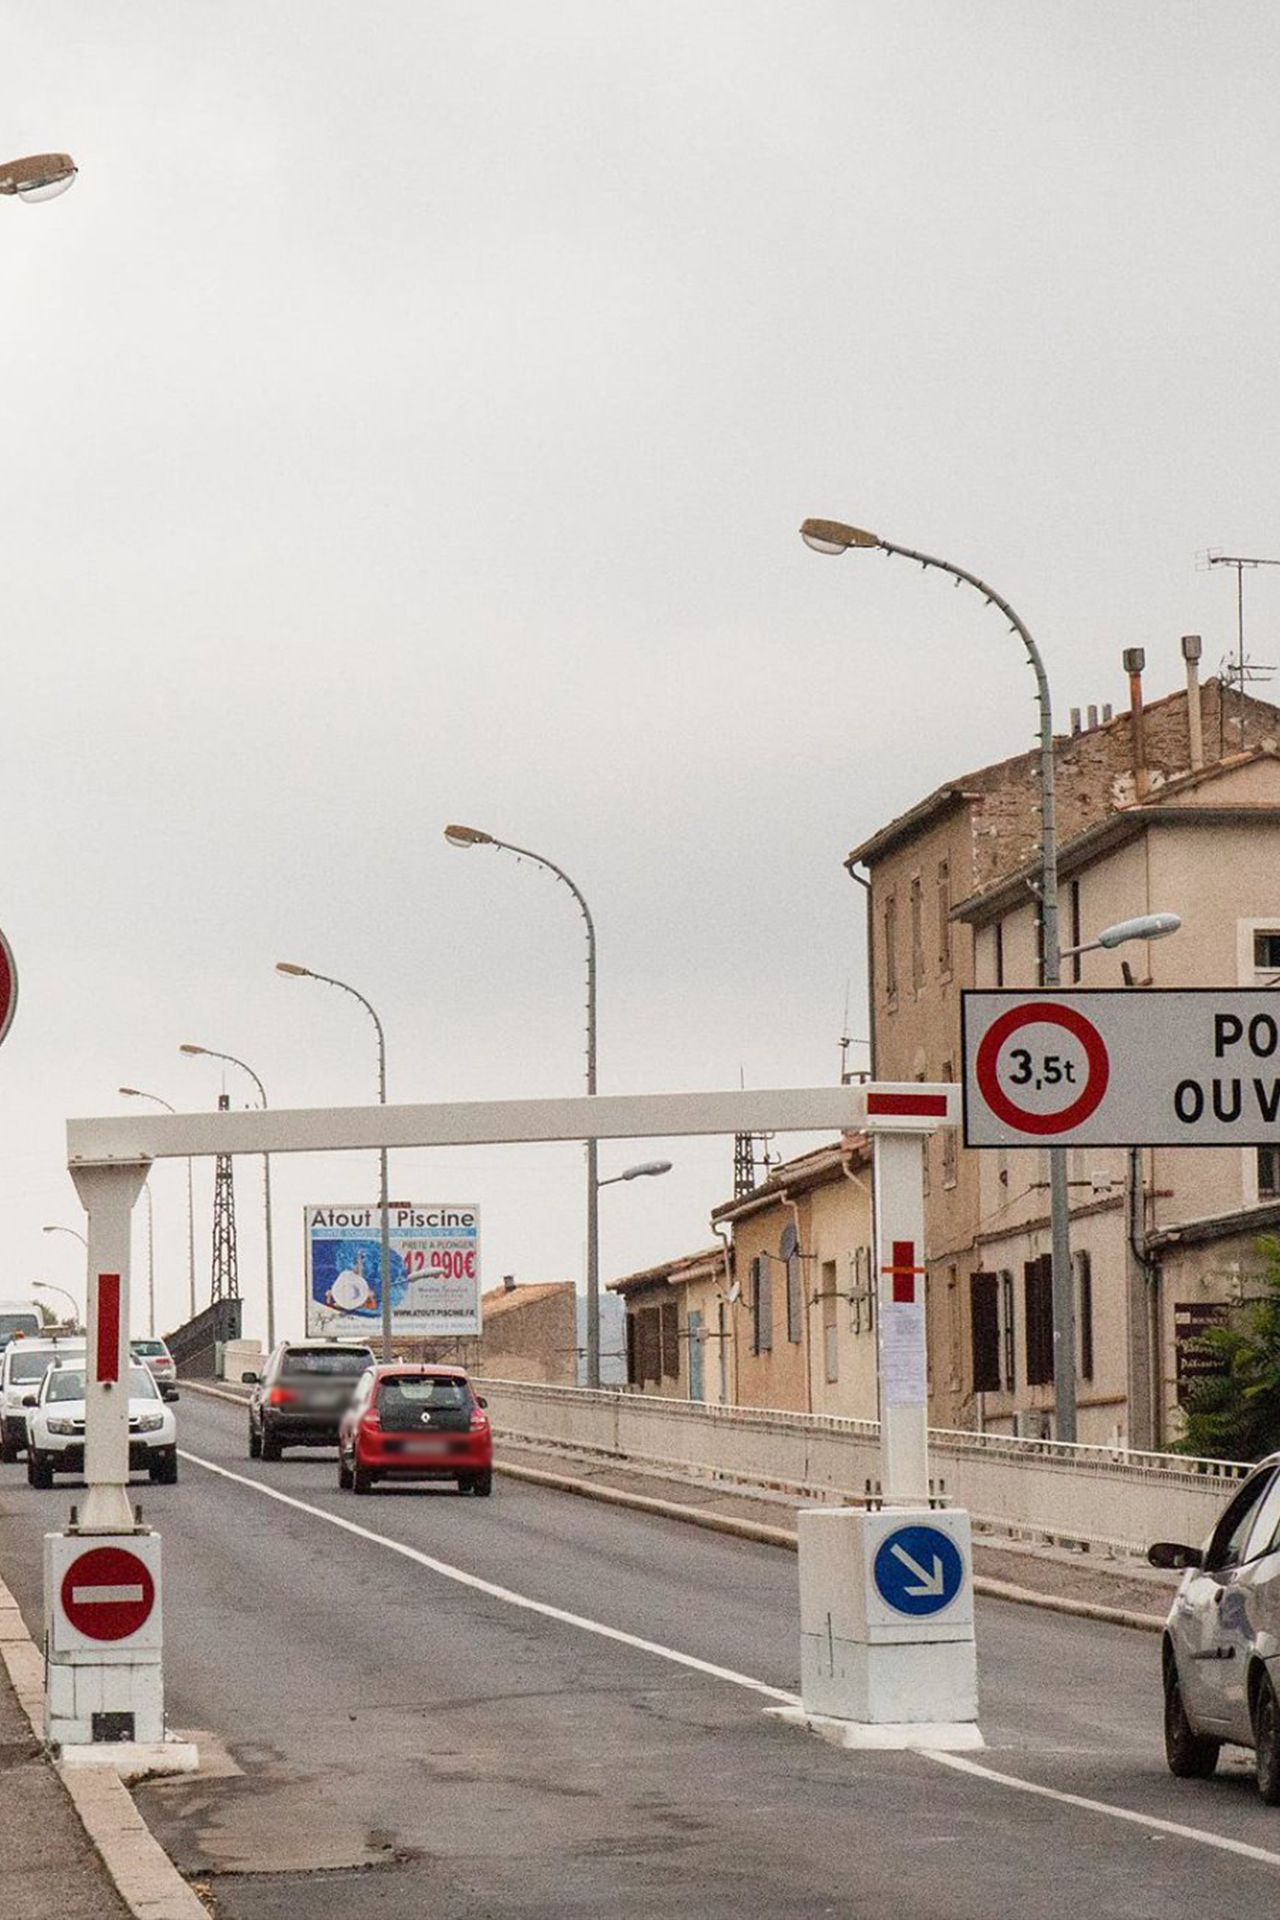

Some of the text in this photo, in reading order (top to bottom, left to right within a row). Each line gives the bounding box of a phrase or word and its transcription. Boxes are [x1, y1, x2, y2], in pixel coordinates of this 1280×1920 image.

[1009, 1049, 1076, 1090] 3,5t
[311, 1210, 474, 1227] Atout Piscine
